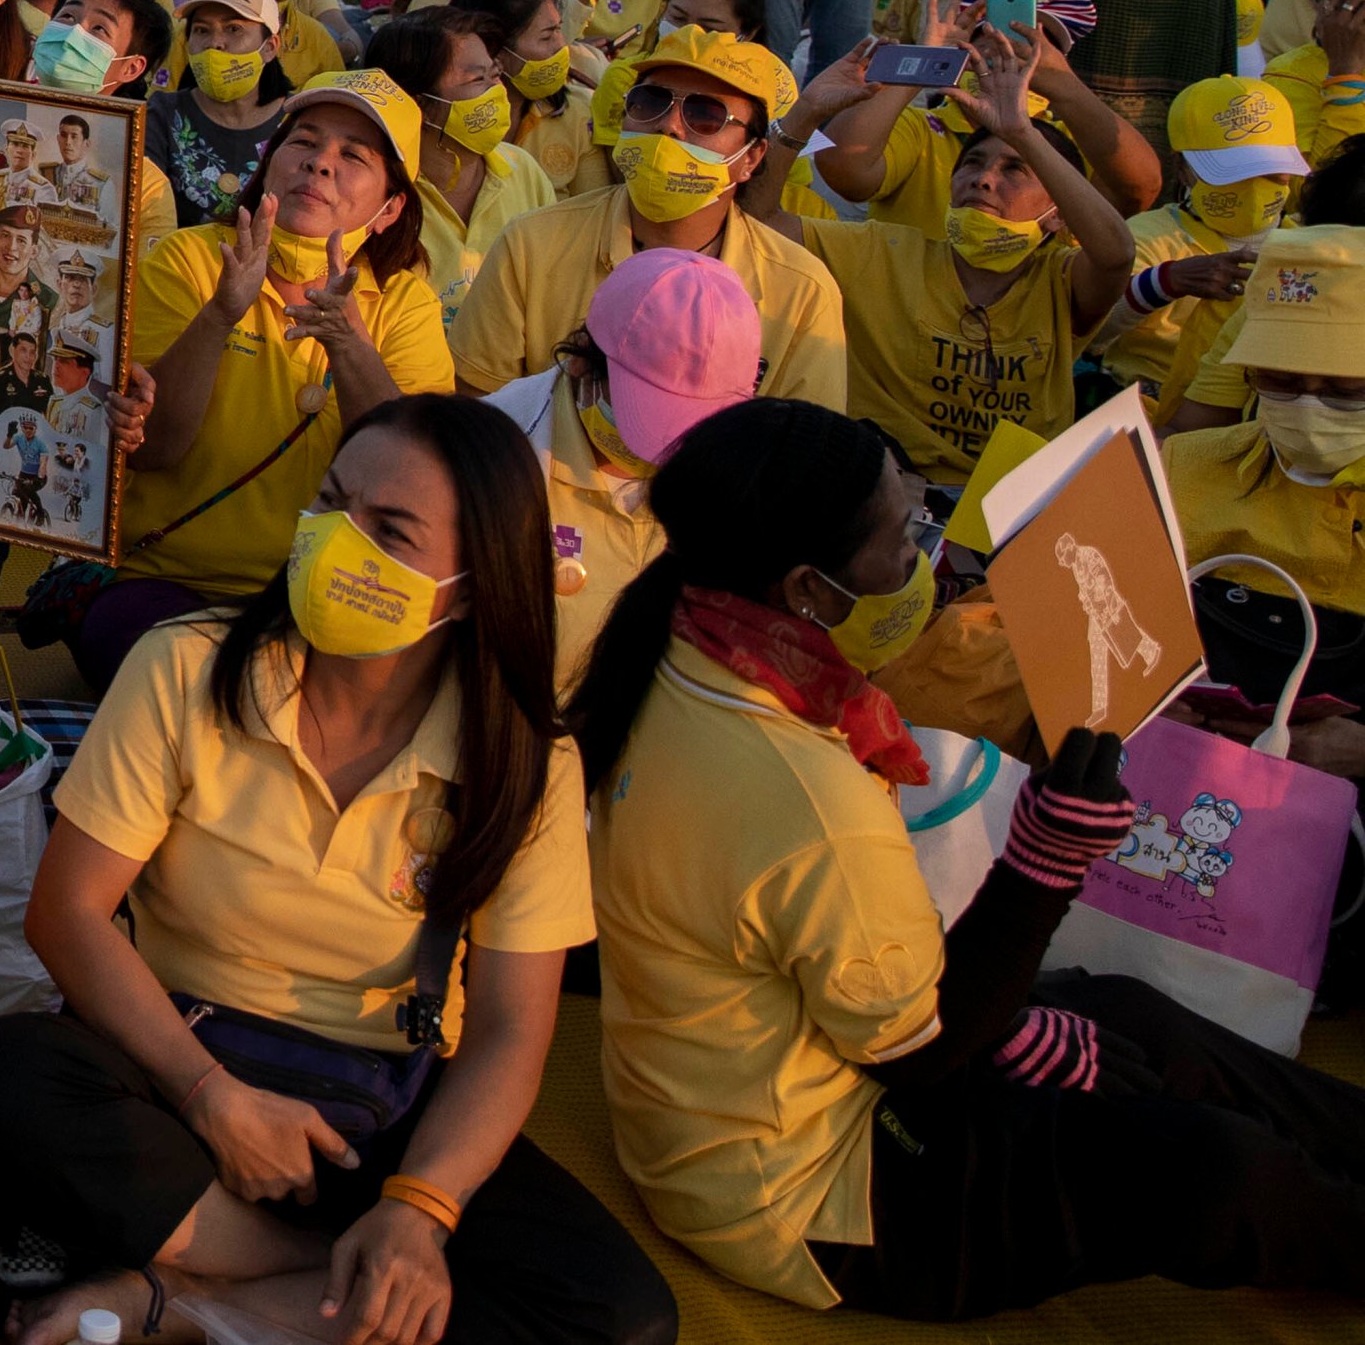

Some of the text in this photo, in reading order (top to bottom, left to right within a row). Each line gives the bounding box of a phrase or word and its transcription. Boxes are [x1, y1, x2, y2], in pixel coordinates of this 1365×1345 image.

[932, 336, 1029, 382] THINK
[931, 375, 1032, 411] of YOUR
